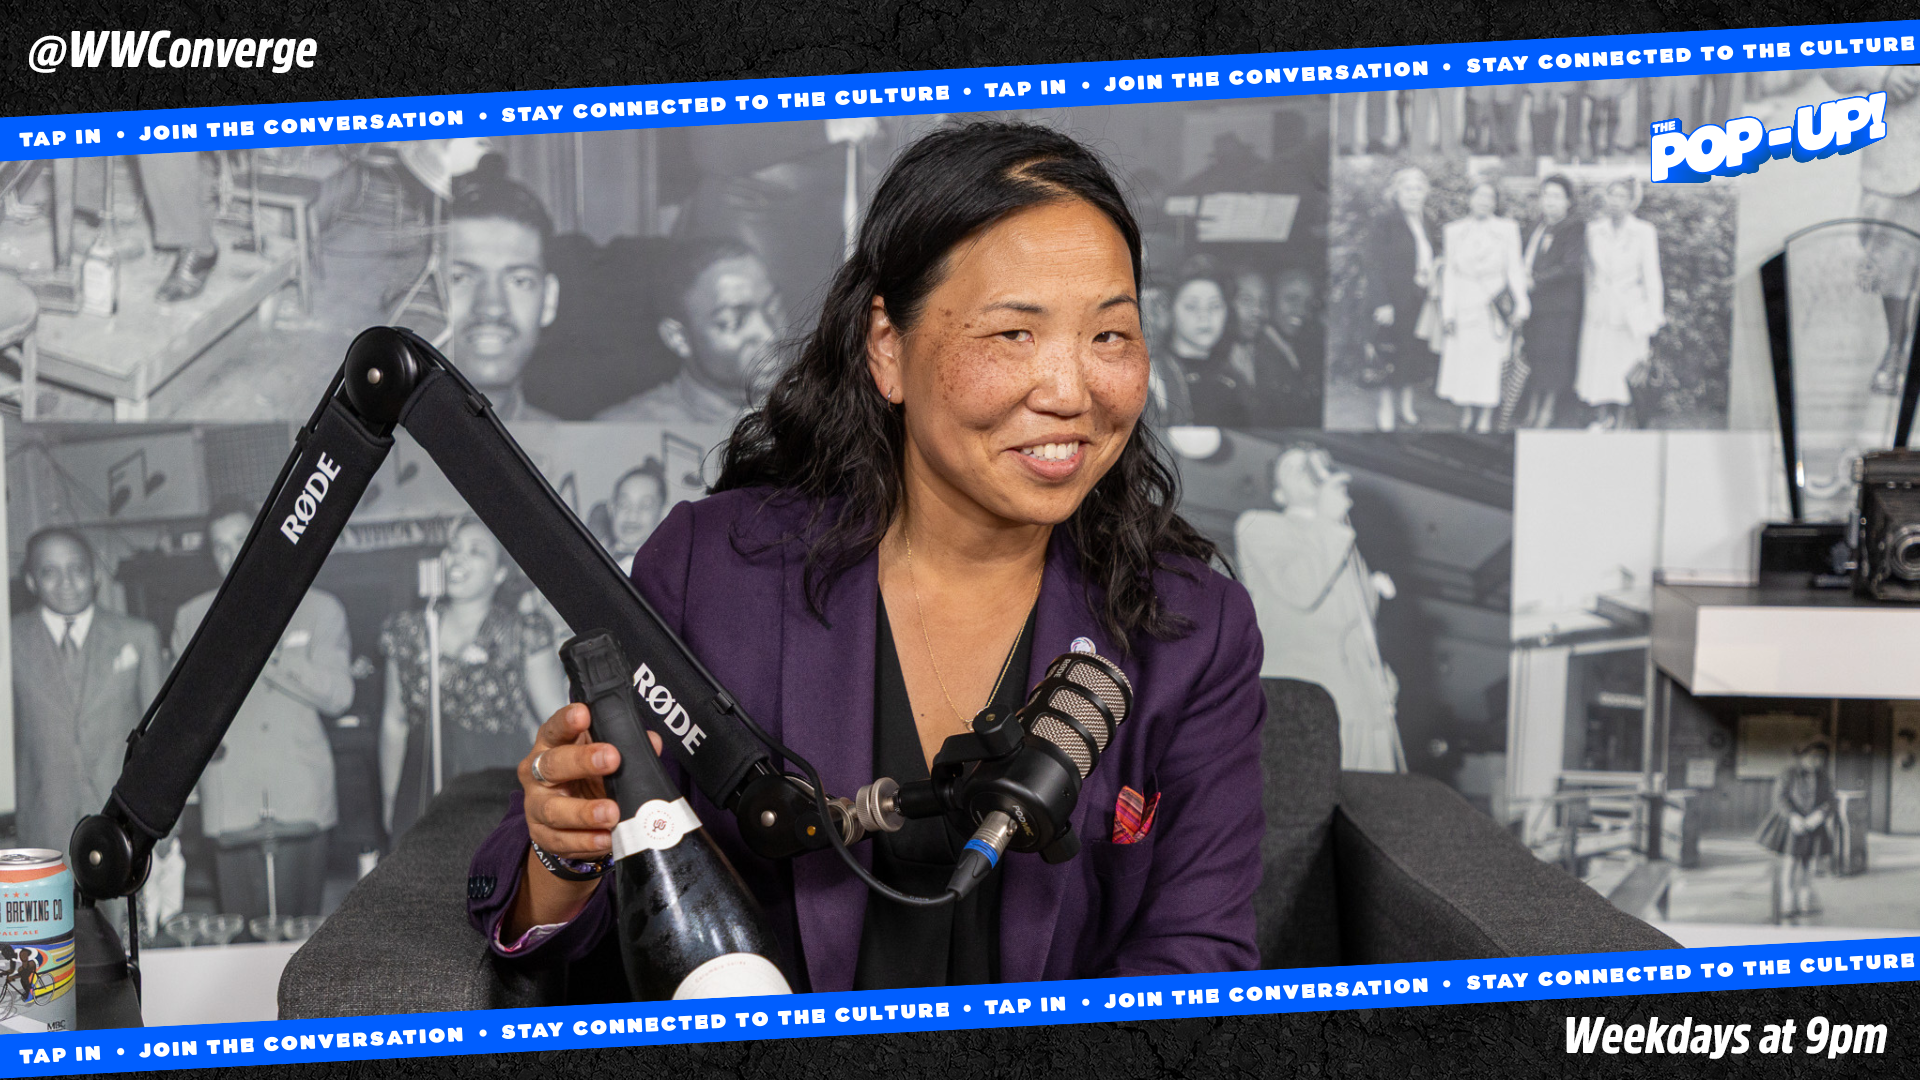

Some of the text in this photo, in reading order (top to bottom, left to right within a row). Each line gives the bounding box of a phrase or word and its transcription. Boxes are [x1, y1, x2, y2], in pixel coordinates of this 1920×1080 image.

[281, 452, 341, 545] RØDE
[633, 662, 707, 755] RØDE
[6, 899, 49, 923] BREWING
[53, 898, 63, 921] CO
